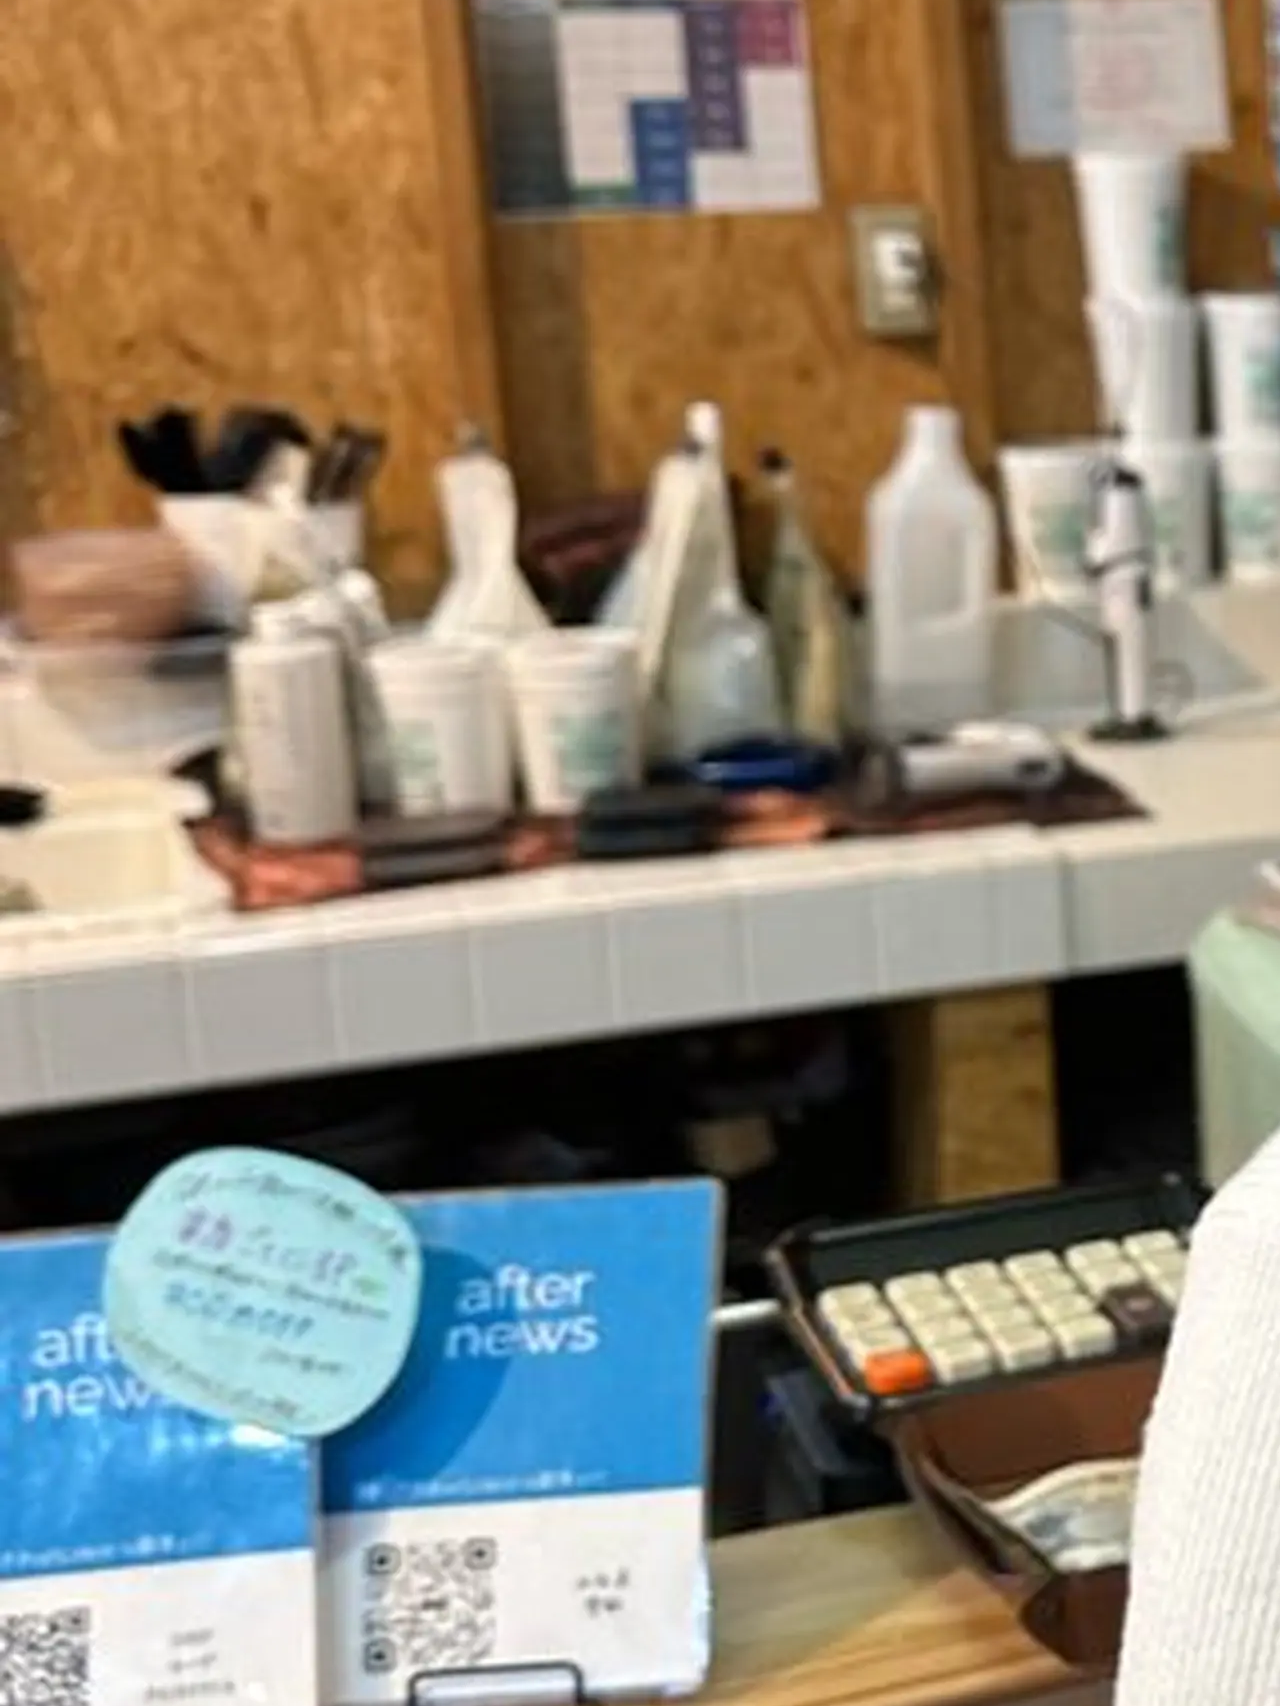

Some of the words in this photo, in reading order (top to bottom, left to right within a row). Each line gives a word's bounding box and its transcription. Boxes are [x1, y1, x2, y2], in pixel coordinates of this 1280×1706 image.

[454, 1262, 598, 1317] after
[30, 1312, 118, 1370] aft
[443, 1314, 601, 1360] news
[21, 1372, 151, 1423] new
